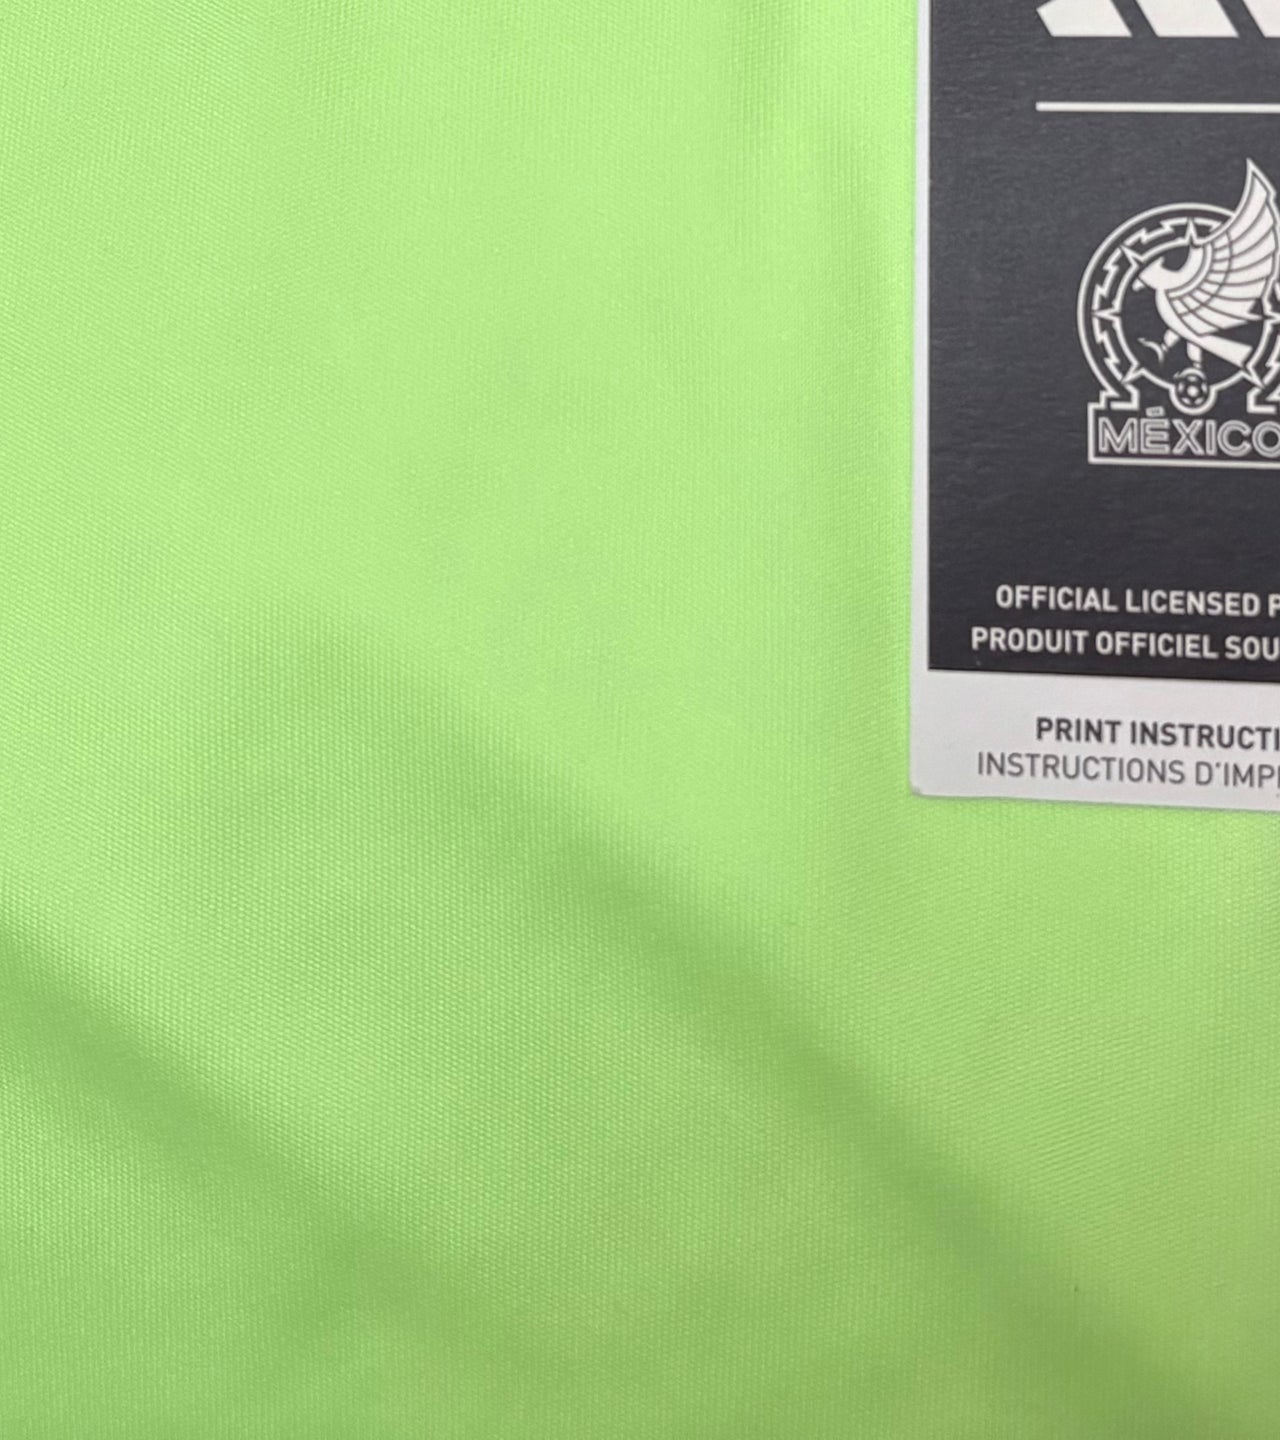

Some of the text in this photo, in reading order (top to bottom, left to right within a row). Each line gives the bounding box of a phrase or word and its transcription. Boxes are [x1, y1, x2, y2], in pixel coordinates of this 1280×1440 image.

[996, 584, 1118, 612] OFFICIAL
[1125, 588, 1260, 616] LICENSED
[971, 626, 1089, 654] PRODUIT
[1095, 631, 1219, 659] OFFICIEL
[1036, 717, 1121, 744] PRINT
[977, 751, 1185, 785] INSTRUCTIONS
